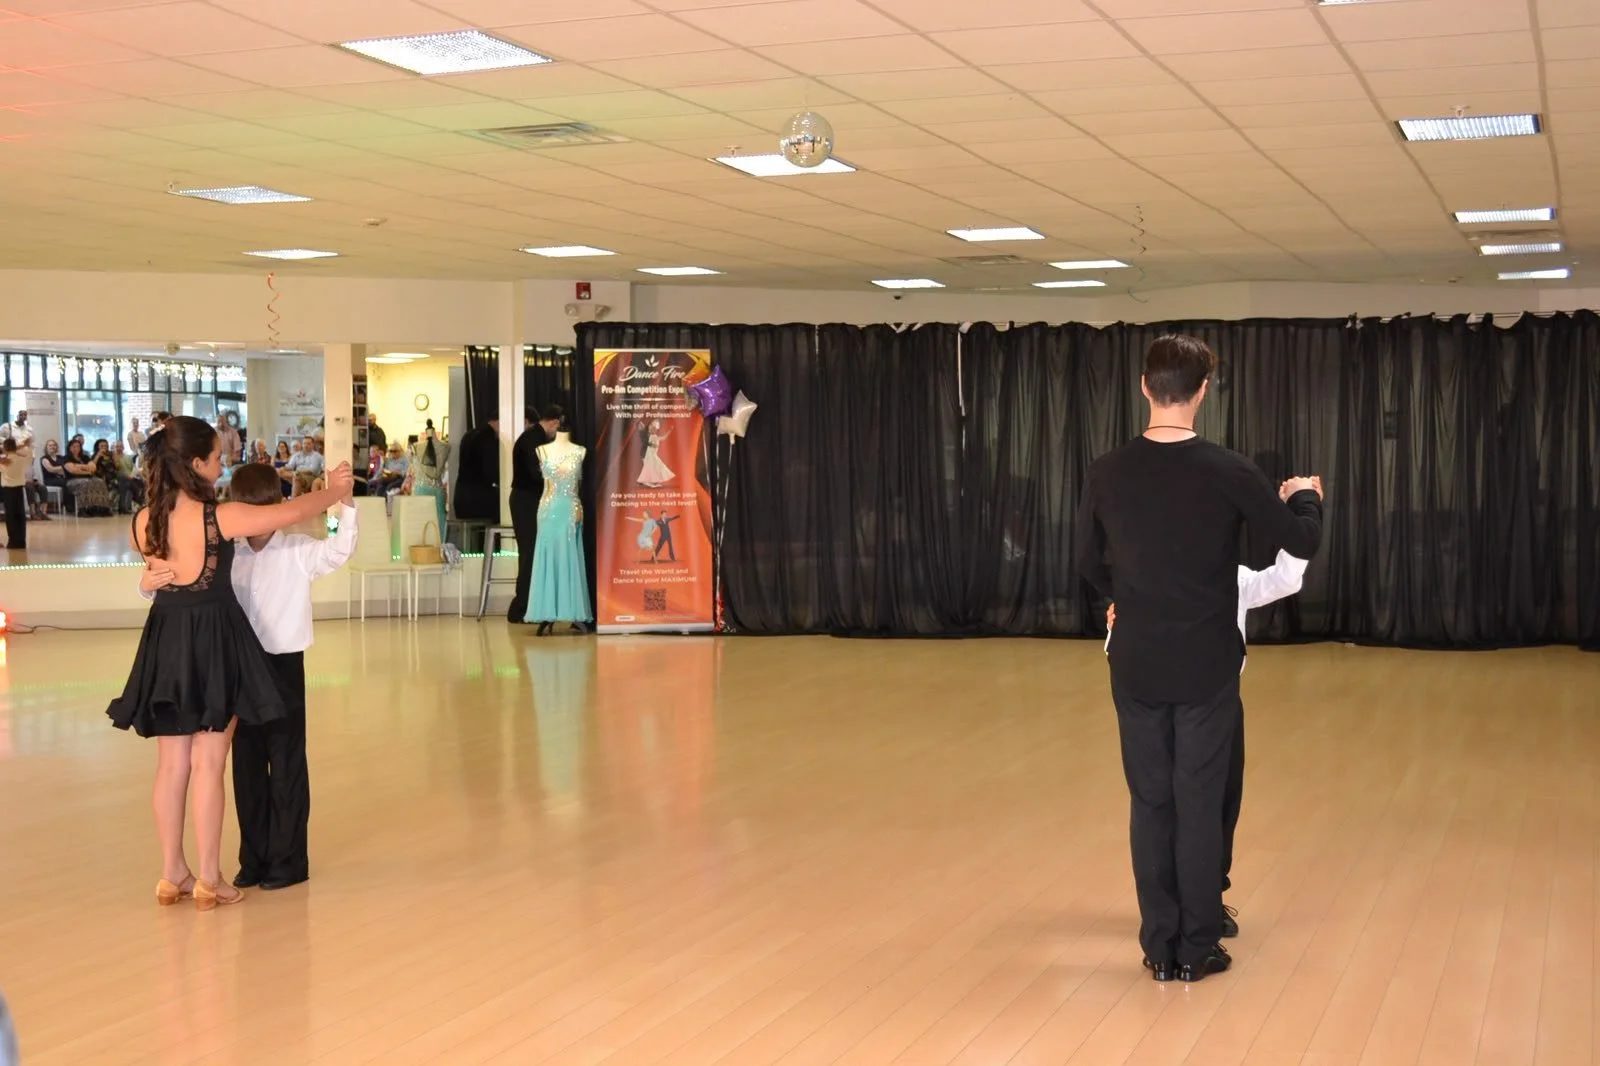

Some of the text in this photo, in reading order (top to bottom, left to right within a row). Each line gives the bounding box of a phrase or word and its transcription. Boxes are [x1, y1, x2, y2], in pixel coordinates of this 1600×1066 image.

[618, 366, 659, 382] Dance
[601, 385, 626, 394] Pro-Am
[627, 385, 667, 396] Competition
